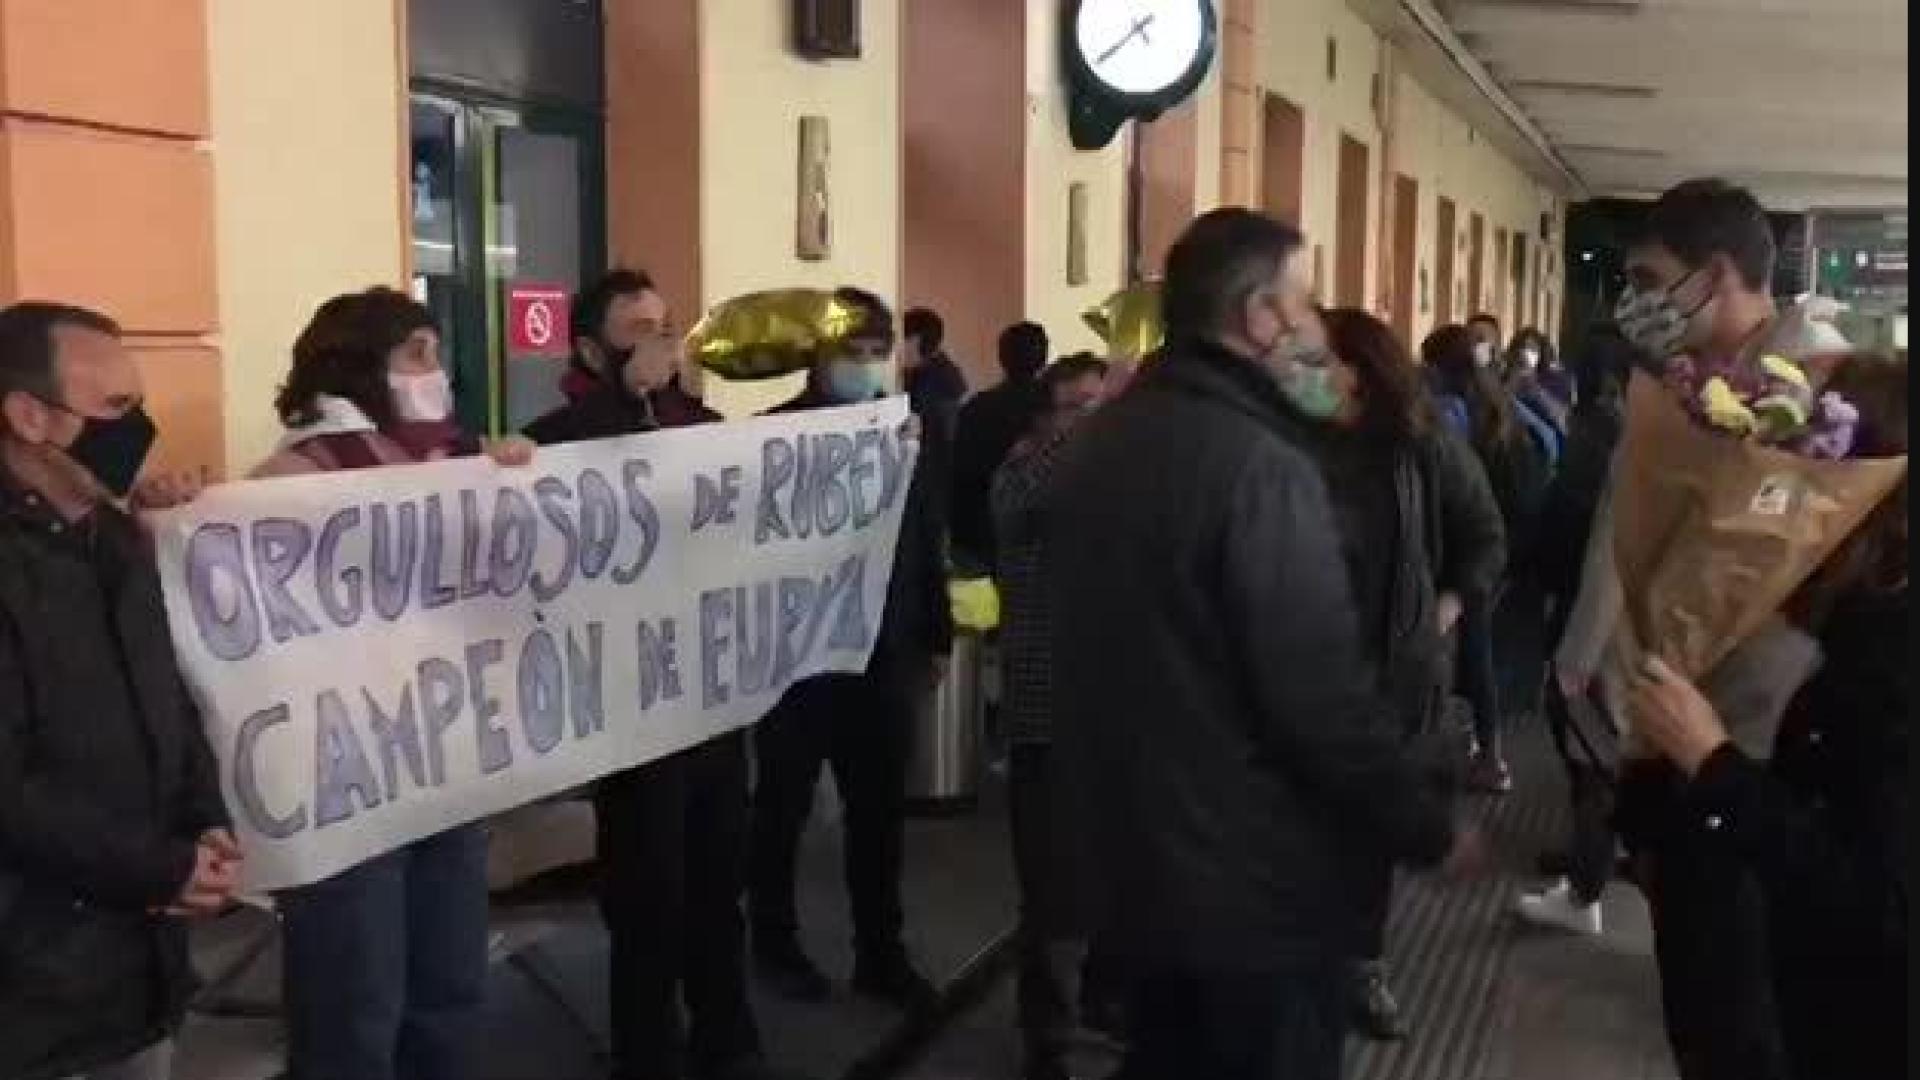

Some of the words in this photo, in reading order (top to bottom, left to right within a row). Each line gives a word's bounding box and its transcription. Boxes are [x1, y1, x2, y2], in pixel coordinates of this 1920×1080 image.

[185, 458, 660, 661] ORGULLOSOS
[690, 465, 742, 532] DE
[755, 416, 906, 544] RUBÉN
[638, 616, 684, 710] DE
